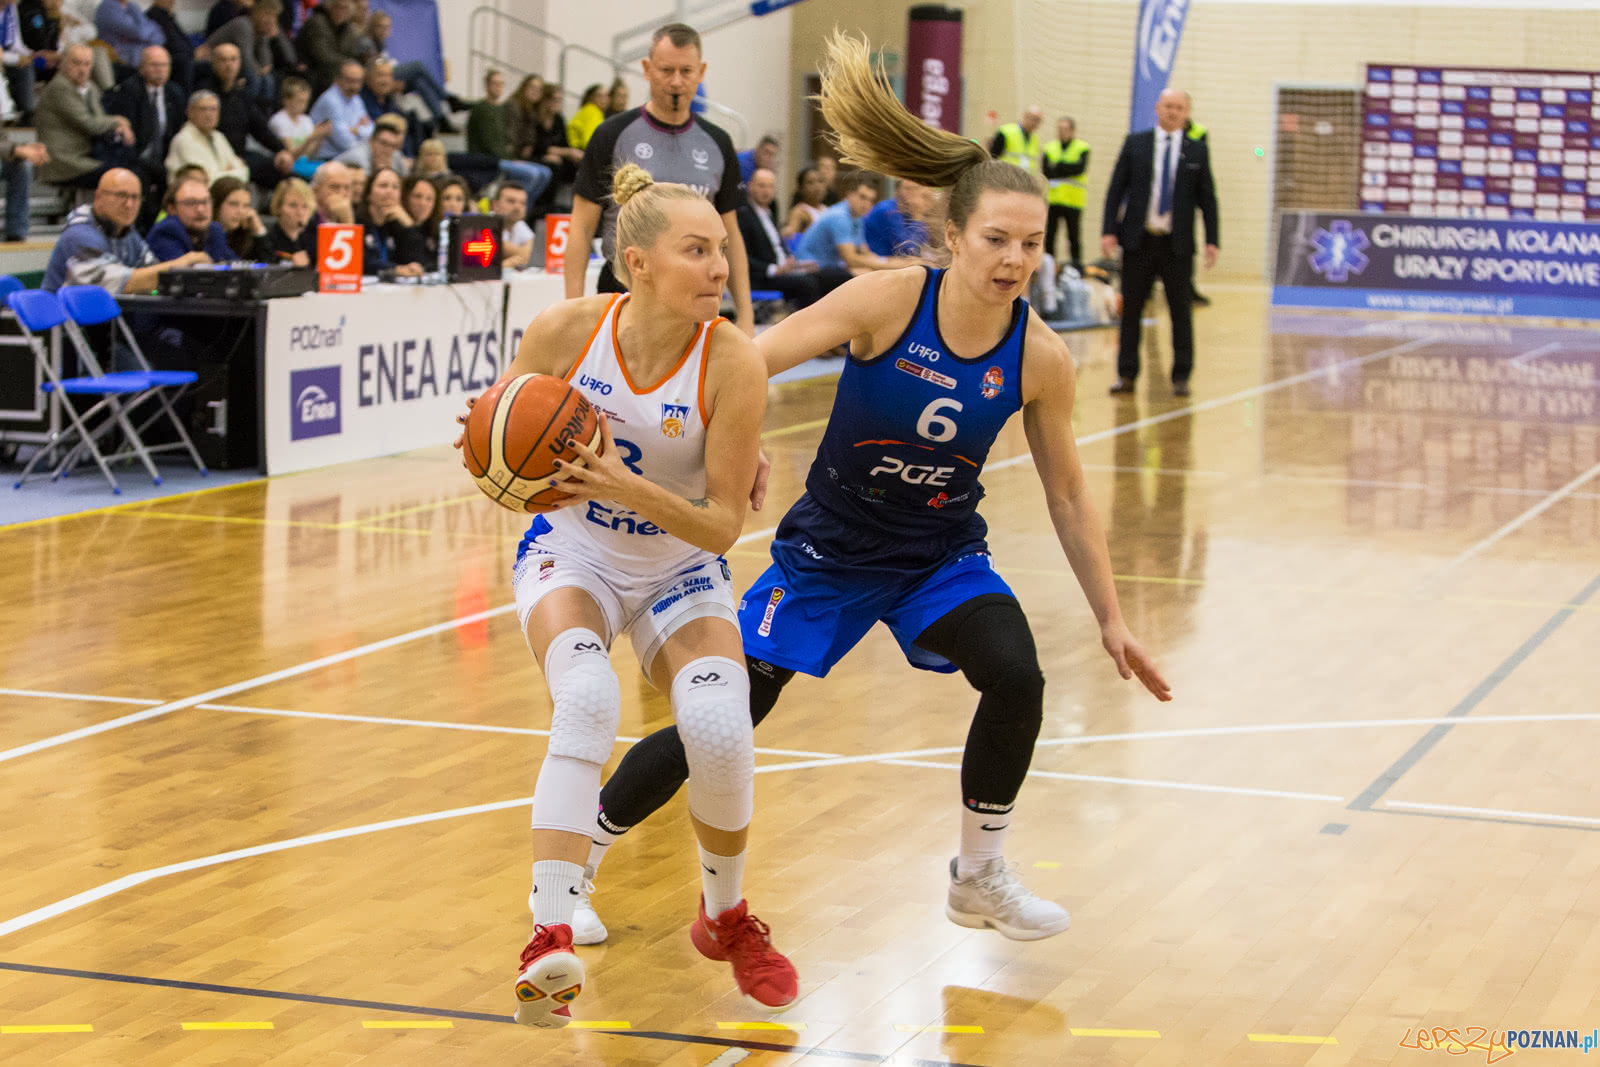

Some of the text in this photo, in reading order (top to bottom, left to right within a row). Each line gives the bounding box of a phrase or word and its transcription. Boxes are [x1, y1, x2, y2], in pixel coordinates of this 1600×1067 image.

[325, 230, 354, 269] 5
[550, 220, 570, 255] 5
[1371, 224, 1600, 256] CHIRURGIA KOLANA
[1393, 255, 1600, 286] URAZY SPORTOWE
[358, 337, 438, 408] ENEA
[446, 331, 497, 394] AZS
[301, 399, 337, 423] Enea
[548, 396, 591, 455] molten
[916, 397, 963, 442] 6
[870, 456, 955, 487] PGE
[586, 500, 668, 536] Ene
